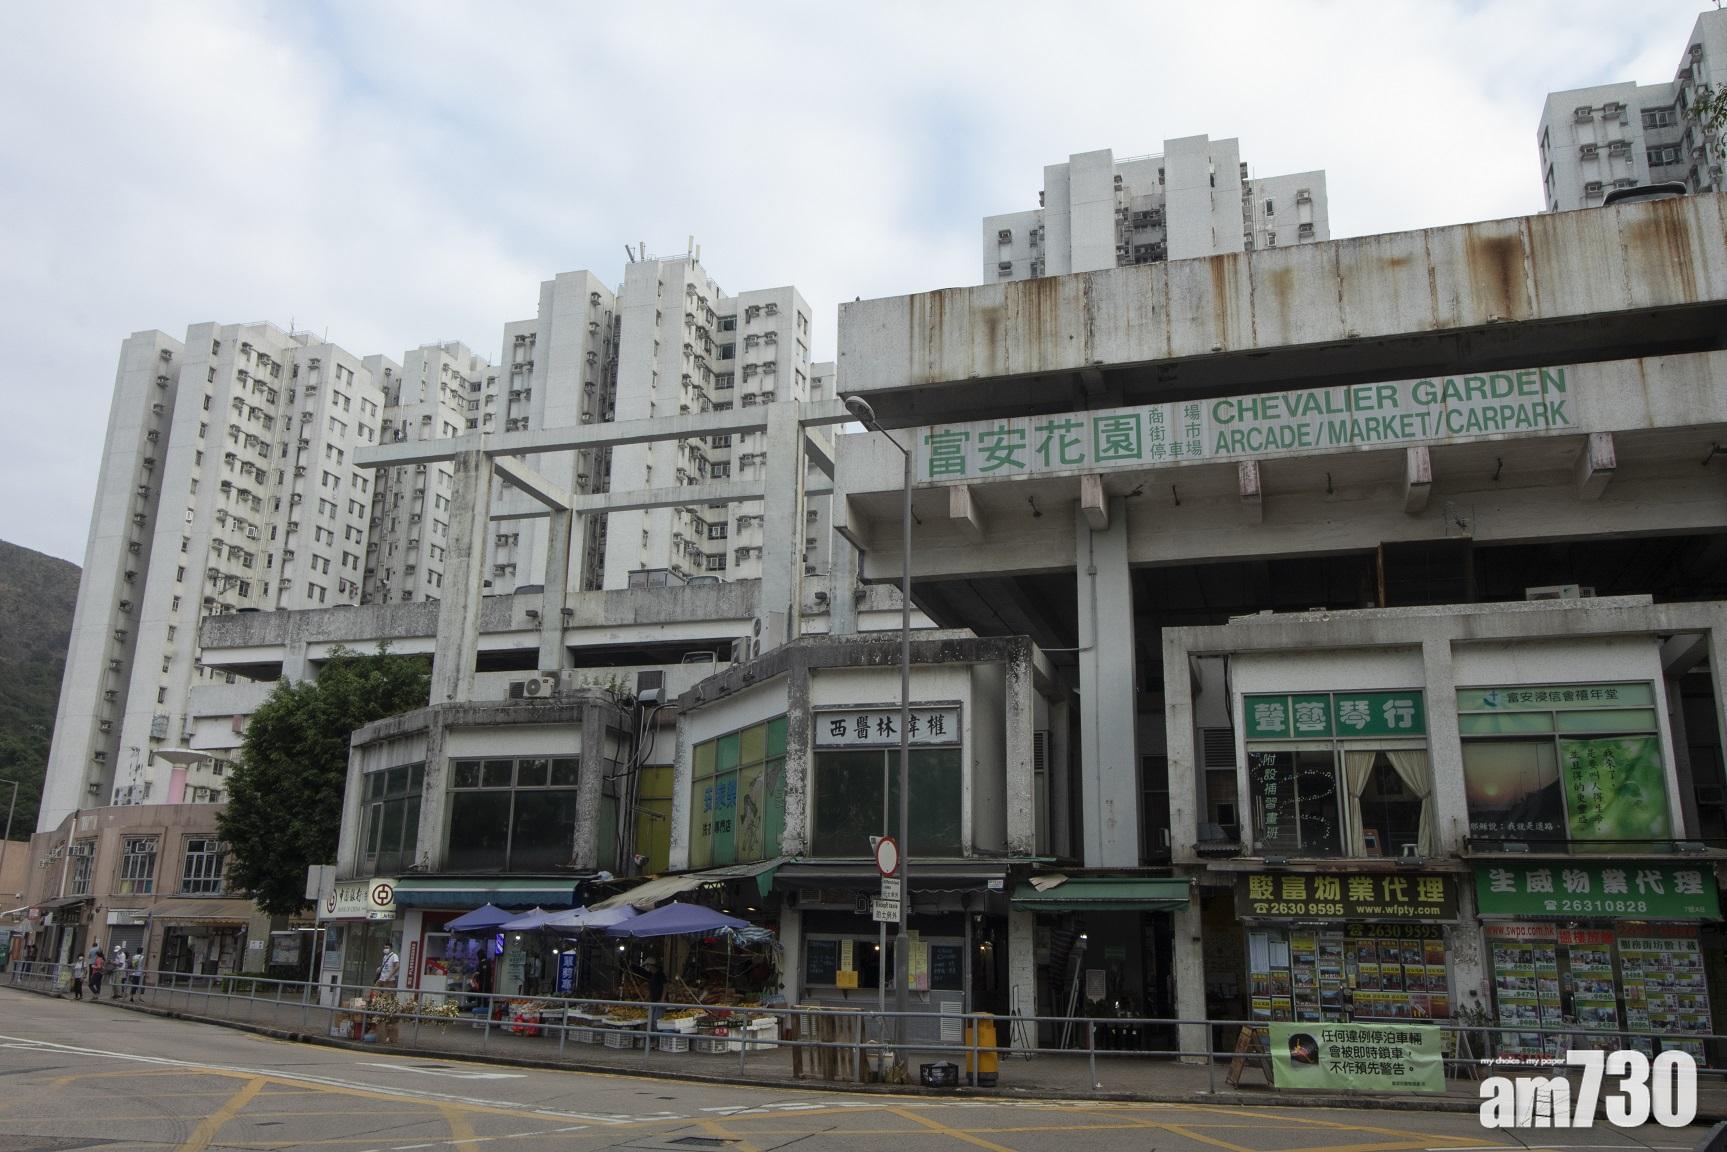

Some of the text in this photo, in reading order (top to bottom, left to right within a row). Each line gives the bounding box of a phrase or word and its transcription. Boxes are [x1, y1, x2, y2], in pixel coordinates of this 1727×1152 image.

[1212, 368, 1567, 425] CHEVALIER GARDEN
[924, 413, 1143, 478] 富安花園
[1149, 438, 1203, 460] 停車場
[1507, 688, 1619, 704] 富安浸信會禧年堂
[1254, 699, 1415, 731] 聲藝琴行
[1248, 875, 1445, 903] 駿富物業代理
[1488, 868, 1705, 895] 生威物業代理
[1270, 903, 1344, 915] 2630 9595
[1356, 905, 1441, 916] www.wfpty.com
[1562, 900, 1647, 913] 26310828
[1367, 924, 1439, 938] 2630 9595
[1321, 1029, 1423, 1046] 任何違例停泊車輛
[1328, 1045, 1413, 1060] 會被即時鎖車，
[1329, 1061, 1415, 1076] 不作預先警告。
